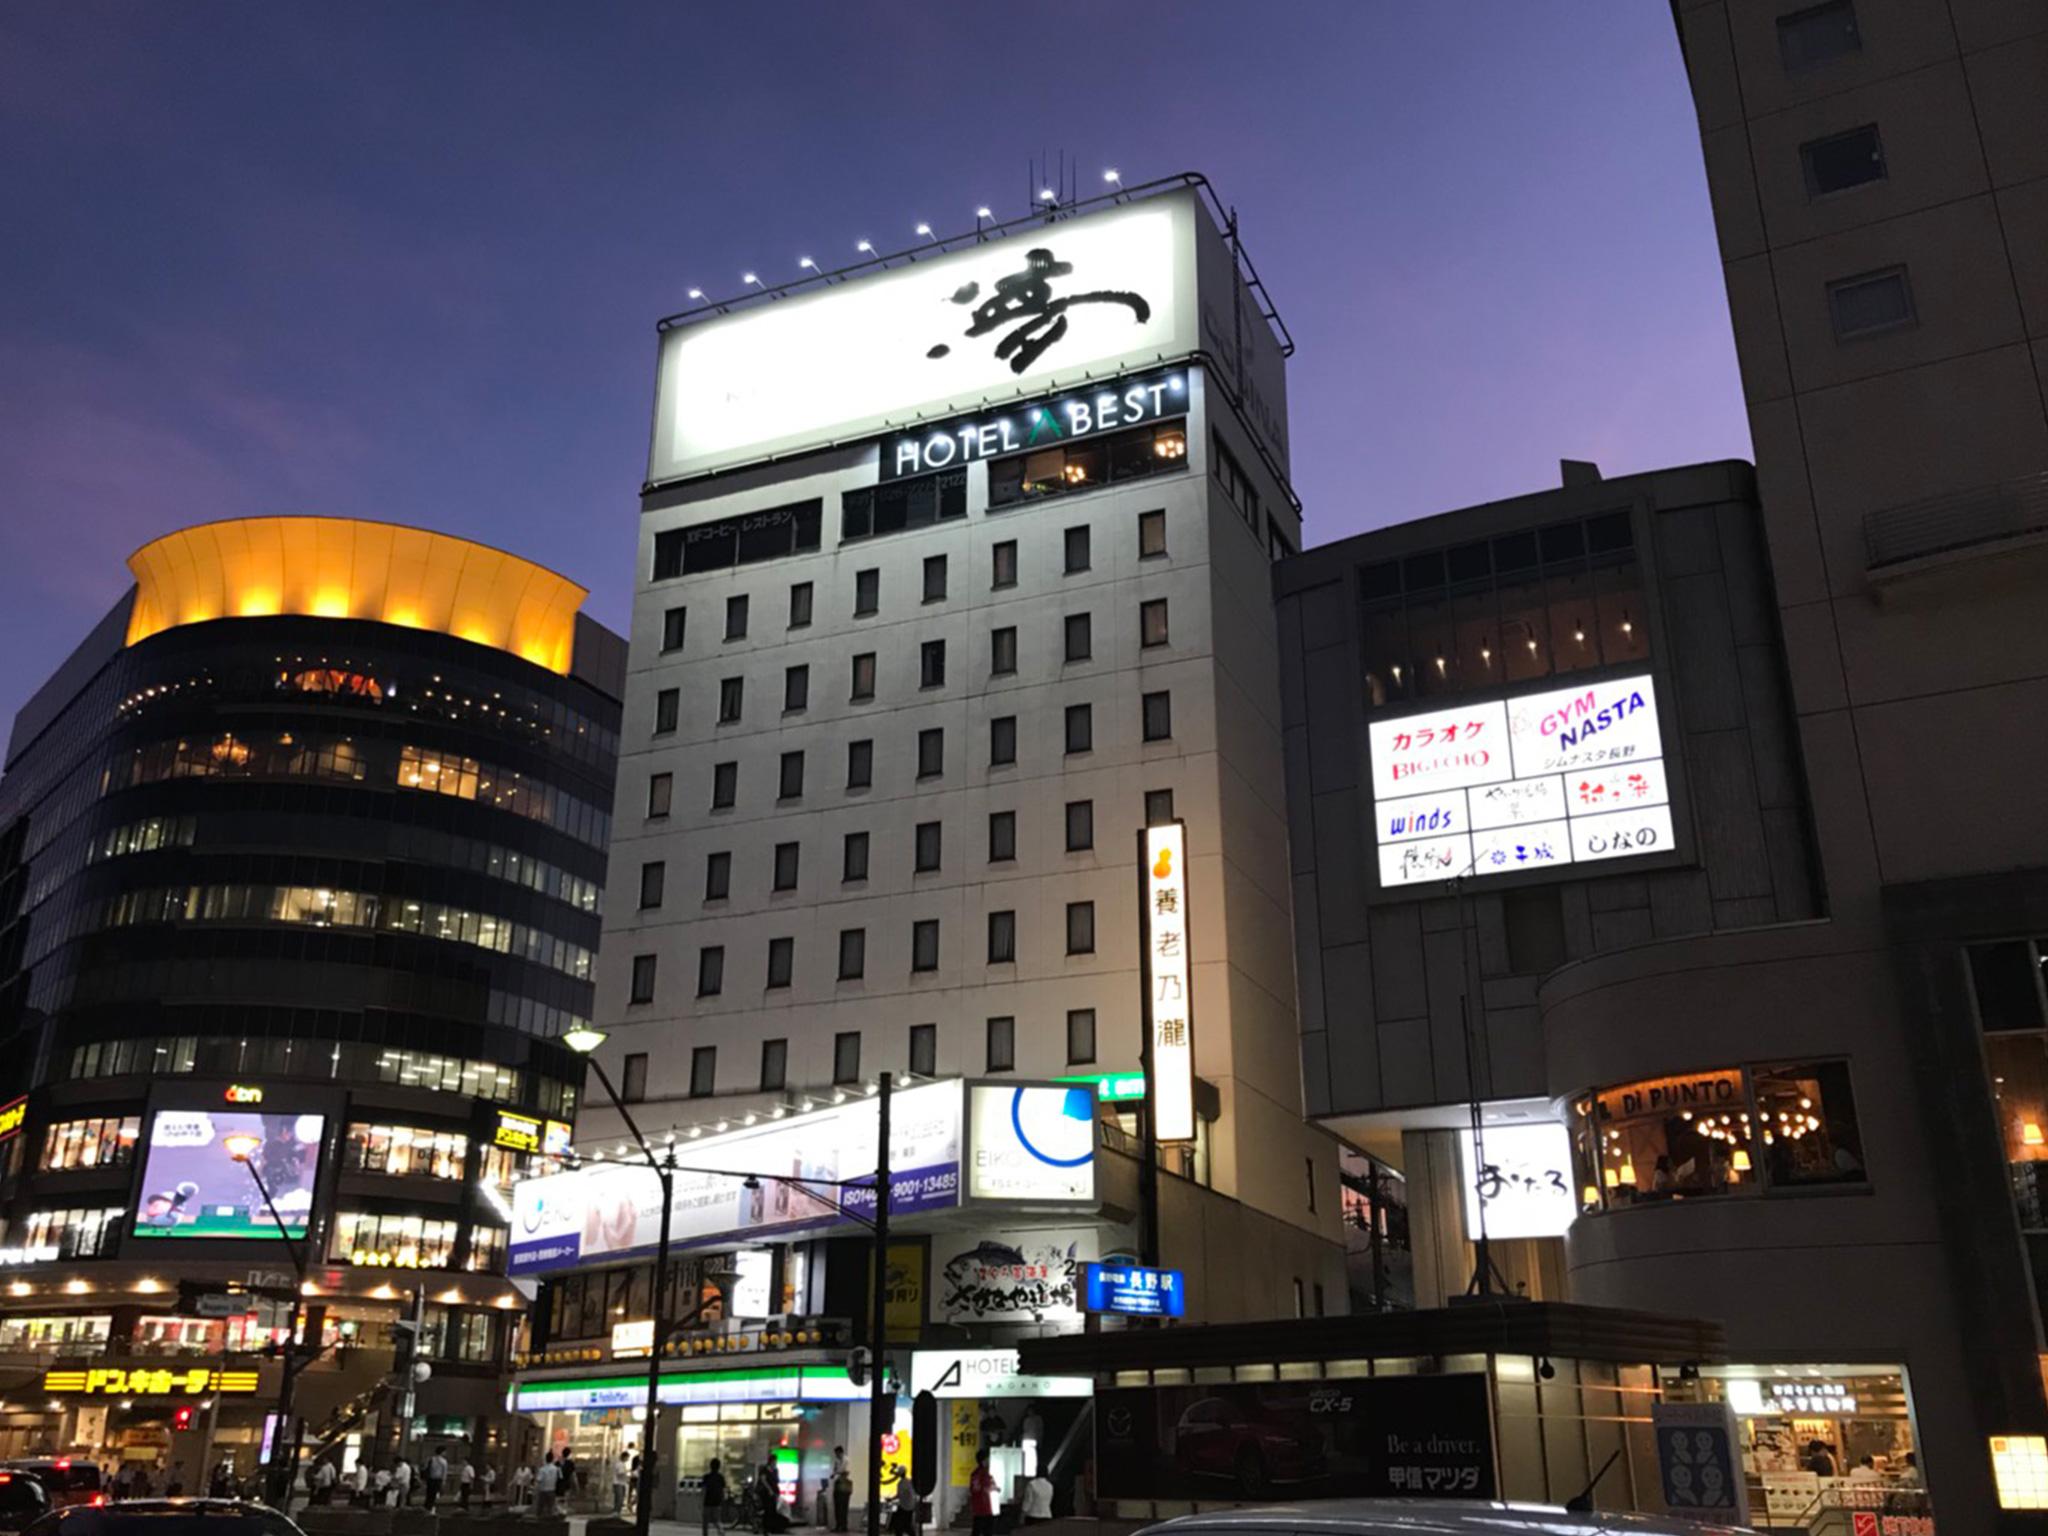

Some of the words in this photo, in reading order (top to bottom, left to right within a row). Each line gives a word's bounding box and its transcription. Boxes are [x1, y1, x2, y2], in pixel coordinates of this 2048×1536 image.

[897, 419, 1020, 475] HOTEL
[1070, 382, 1167, 436] BEST
[1540, 690, 1596, 736] GYM
[1560, 691, 1646, 752] NASTA
[1392, 721, 1485, 751] カラオケ
[1390, 807, 1452, 836] winds
[1588, 827, 1657, 854] しなの
[1154, 888, 1187, 1047] 養老乃瀧
[1621, 1089, 1643, 1115] DI
[1648, 1078, 1734, 1109] PUNTO
[1130, 1270, 1174, 1292] 長野駅
[966, 1357, 1017, 1374] HOTEL
[985, 1381, 1051, 1390] NAGANO
[1309, 1397, 1354, 1413] CX-5
[1386, 1434, 1409, 1455] Be
[1412, 1439, 1423, 1454] a
[1426, 1433, 1481, 1455] driver.
[1387, 1466, 1480, 1492] 甲信マツダ
